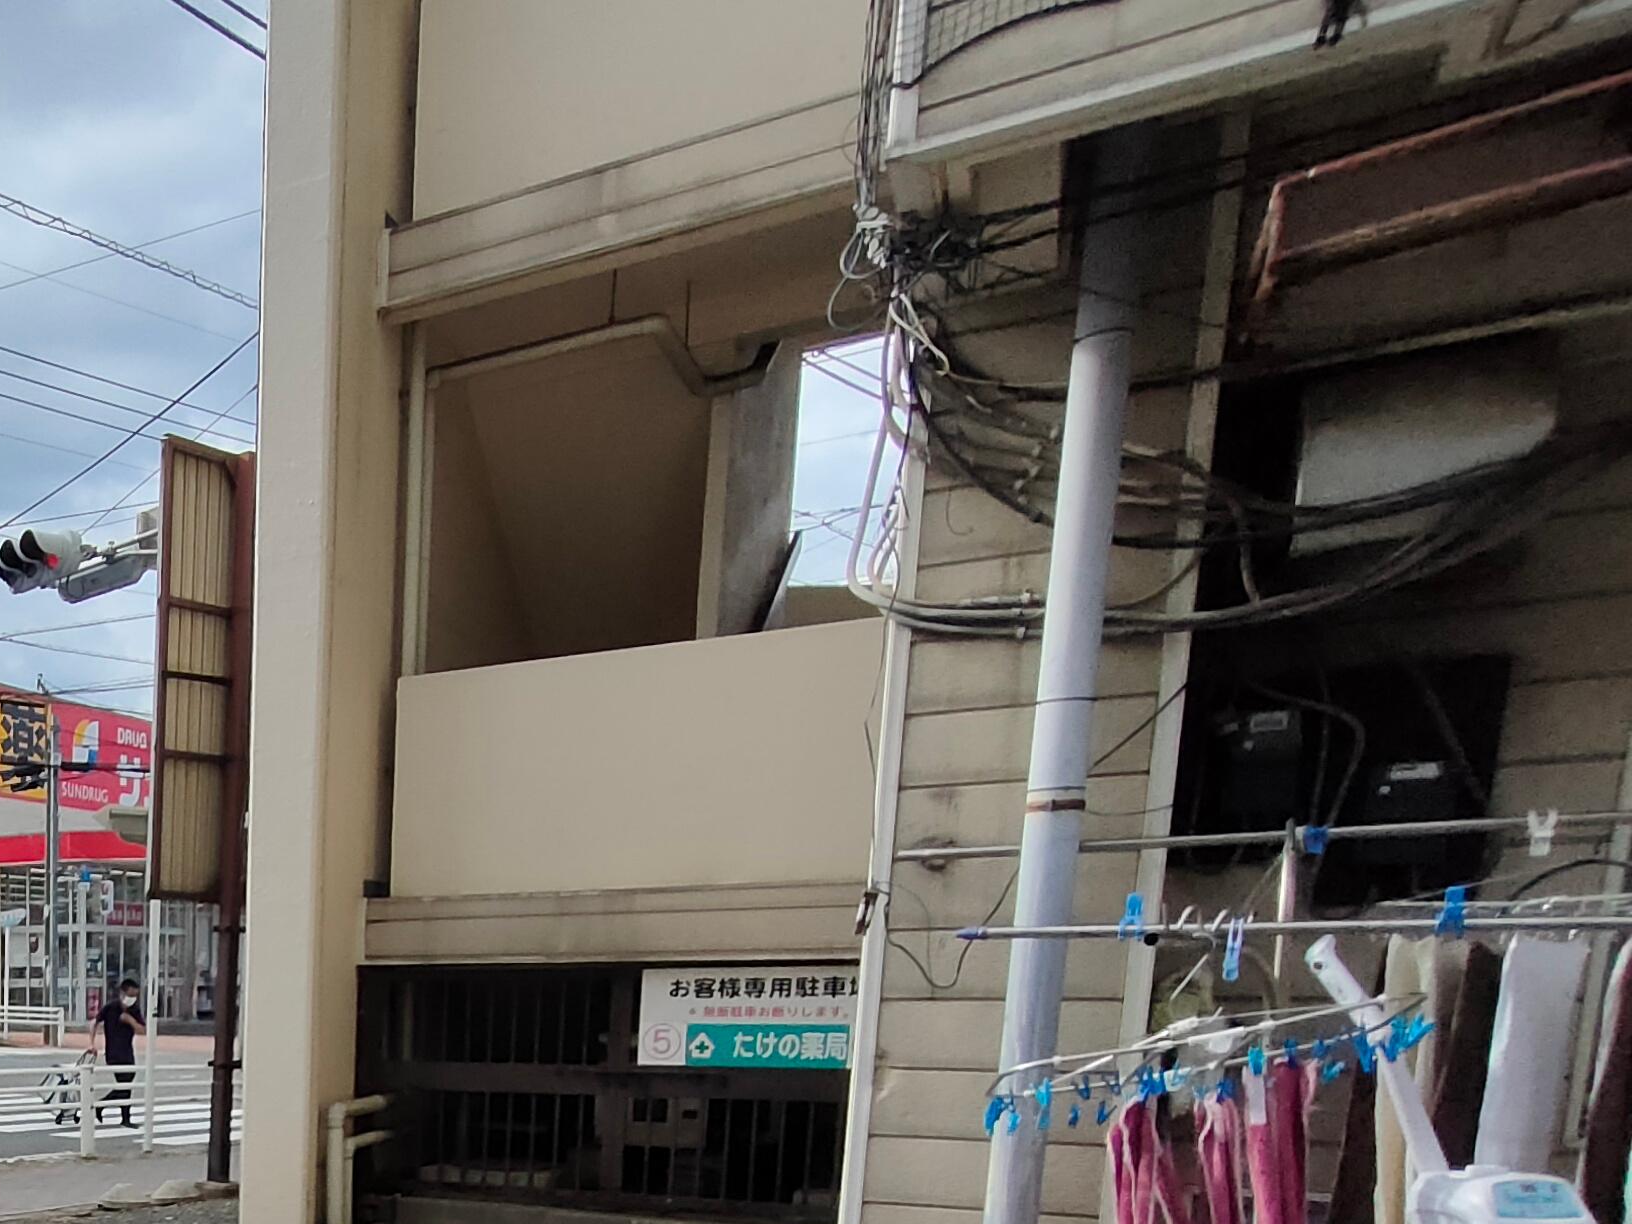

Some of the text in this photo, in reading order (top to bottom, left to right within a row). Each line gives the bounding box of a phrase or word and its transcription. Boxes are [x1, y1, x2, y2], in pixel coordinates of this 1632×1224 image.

[62, 780, 109, 802] SUNDRUG
[117, 754, 150, 807] サ
[733, 1031, 848, 1061] たけの薬局
